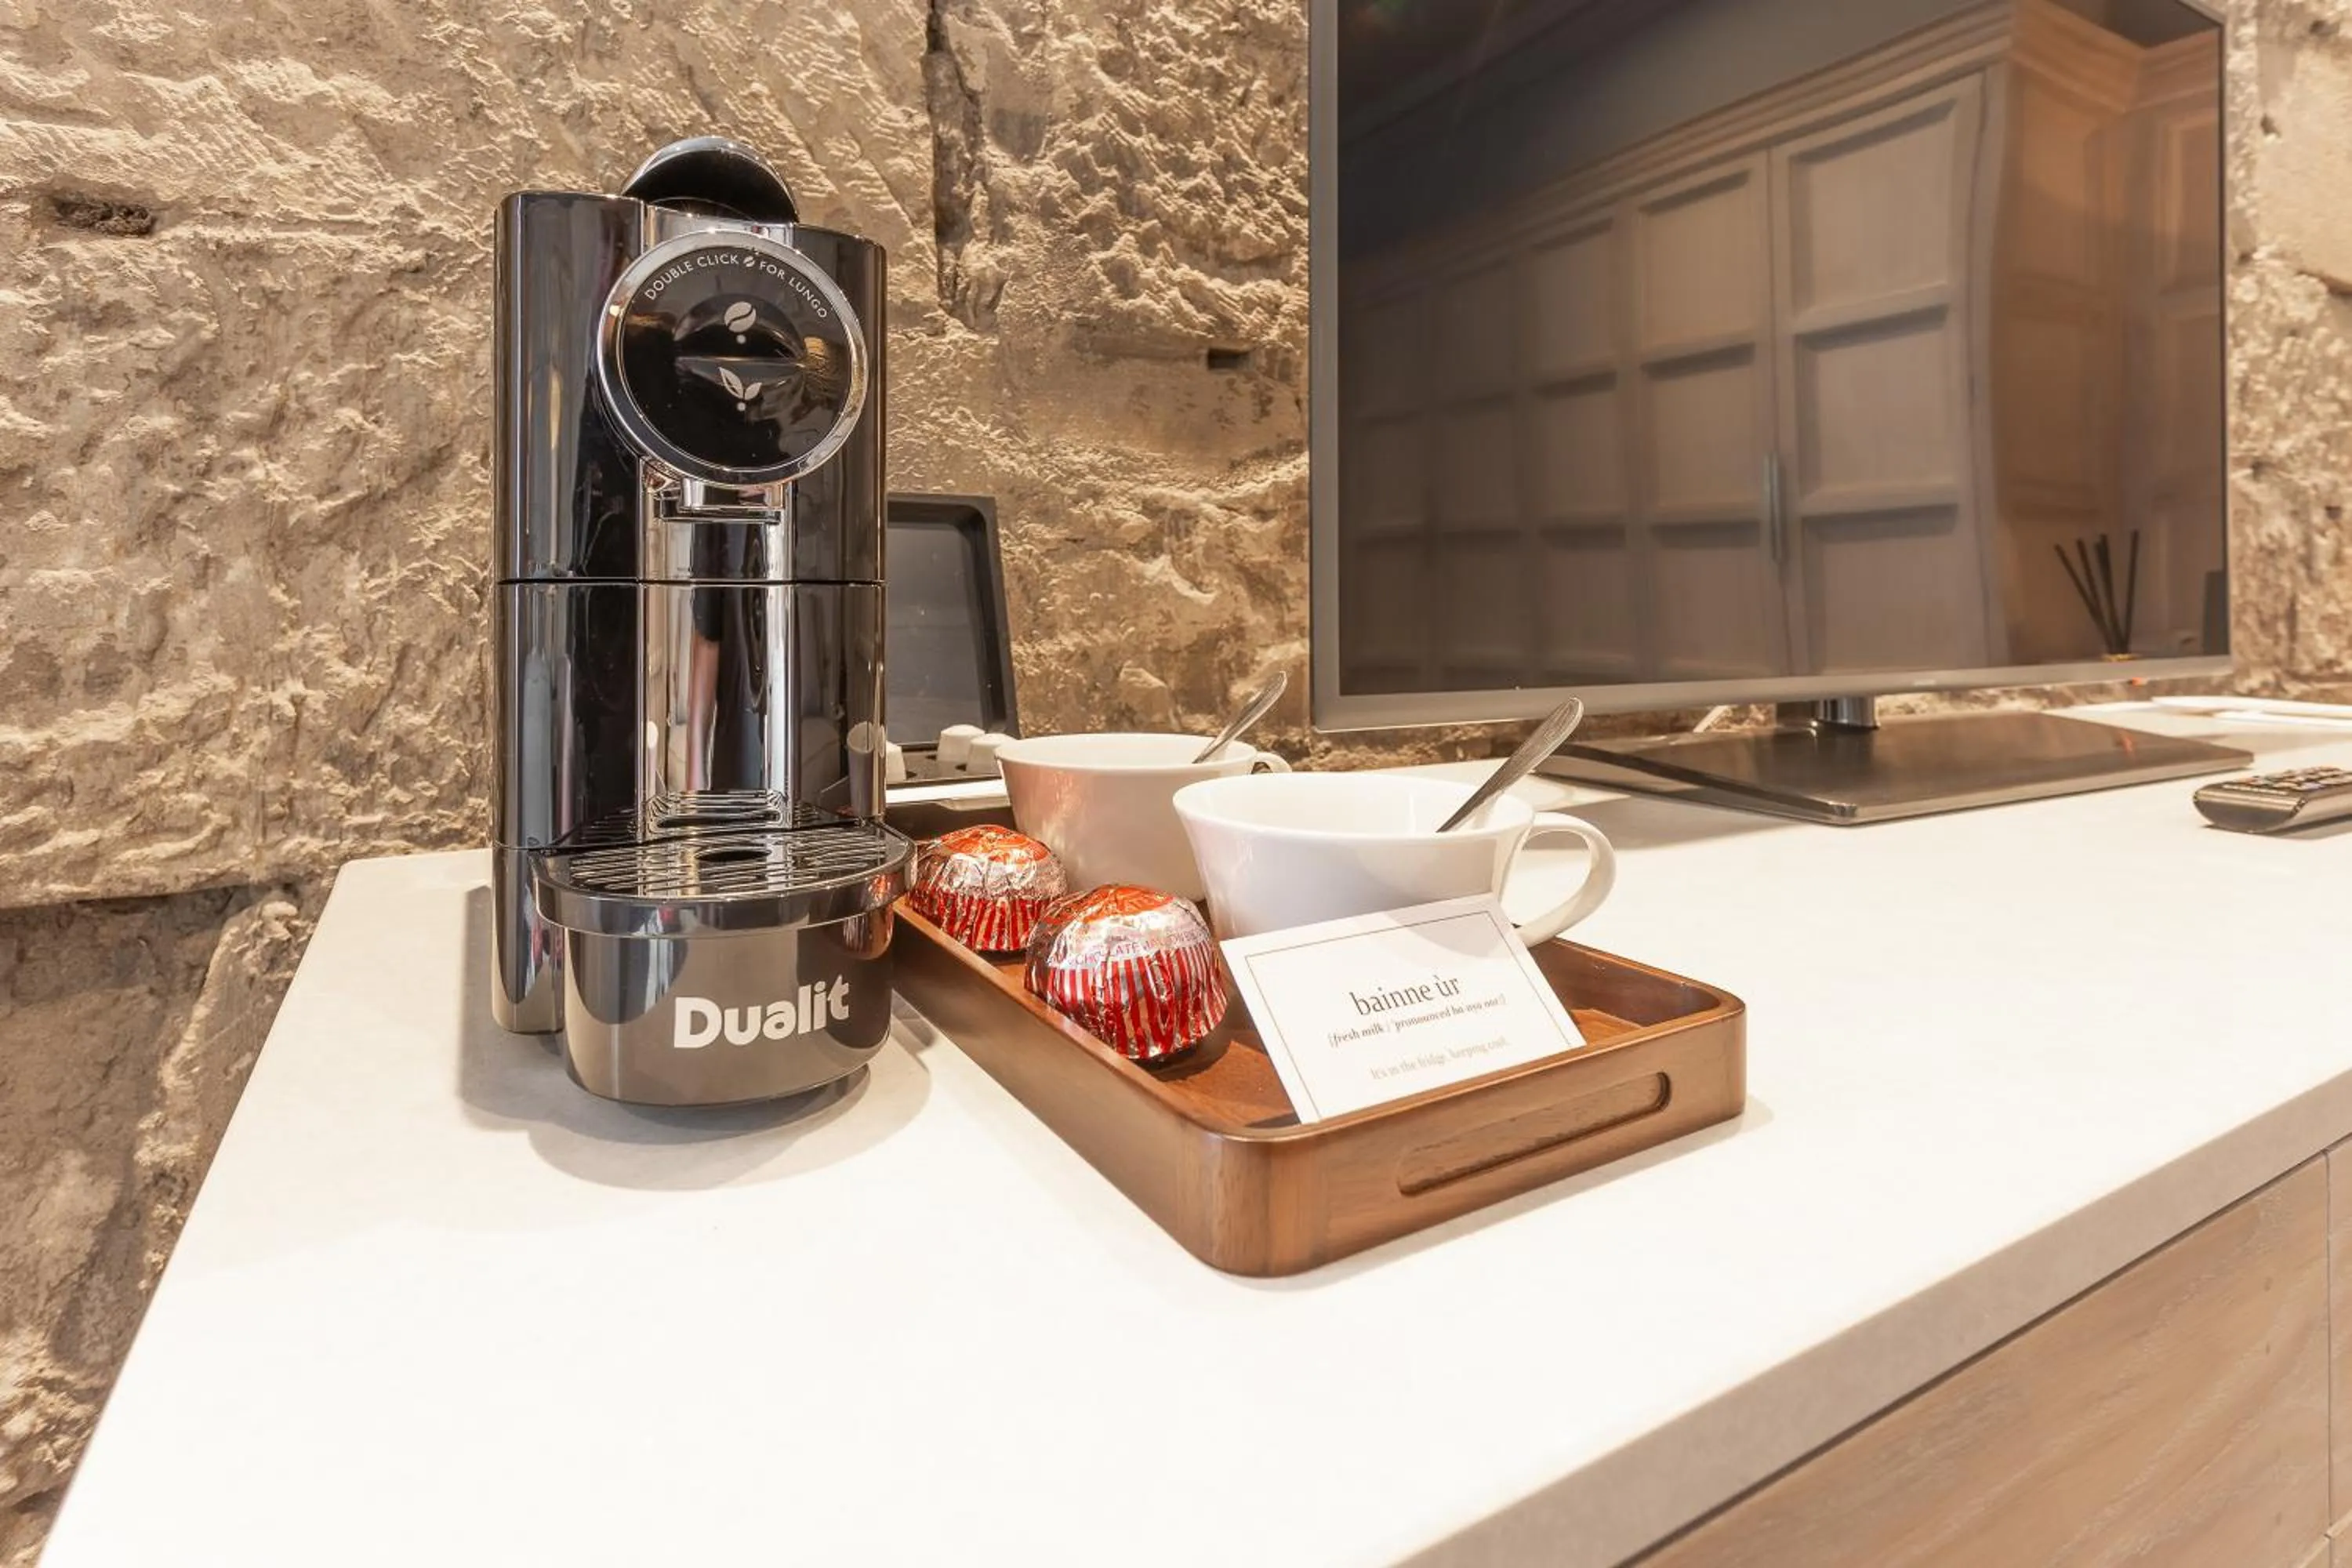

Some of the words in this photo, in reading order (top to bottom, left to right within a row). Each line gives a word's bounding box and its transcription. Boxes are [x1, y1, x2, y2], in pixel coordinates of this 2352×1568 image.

[644, 260, 694, 300] DOUBLE
[697, 253, 739, 267] CLICK
[759, 260, 785, 280] FOR
[788, 277, 828, 319] LUNGO
[673, 974, 850, 1049] Dualit
[1348, 983, 1434, 1016] bainne
[1361, 1022, 1385, 1036] milk
